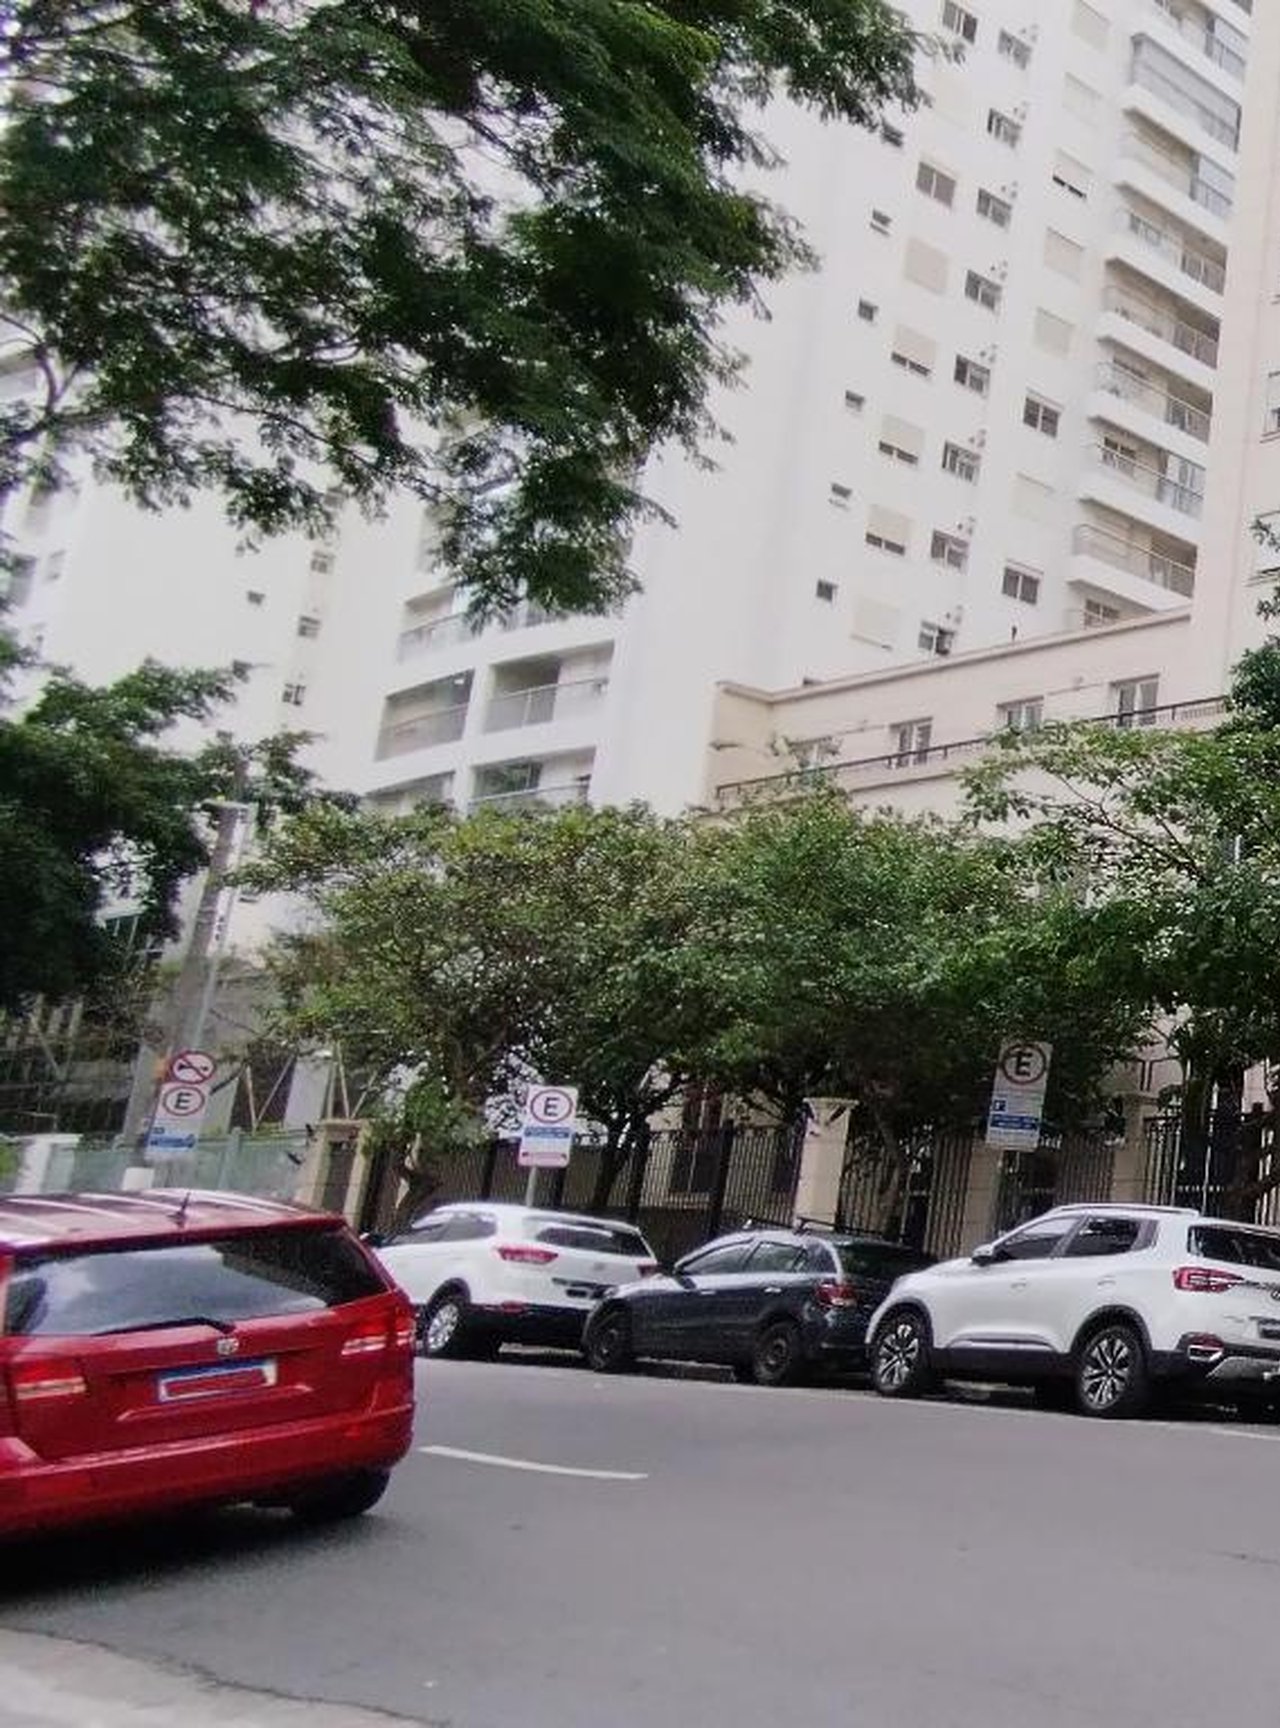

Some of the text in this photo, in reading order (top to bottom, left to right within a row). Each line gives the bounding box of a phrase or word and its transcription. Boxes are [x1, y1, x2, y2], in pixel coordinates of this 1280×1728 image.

[1015, 1050, 1033, 1077] E
[174, 1092, 193, 1110] E
[543, 1096, 560, 1117] E
